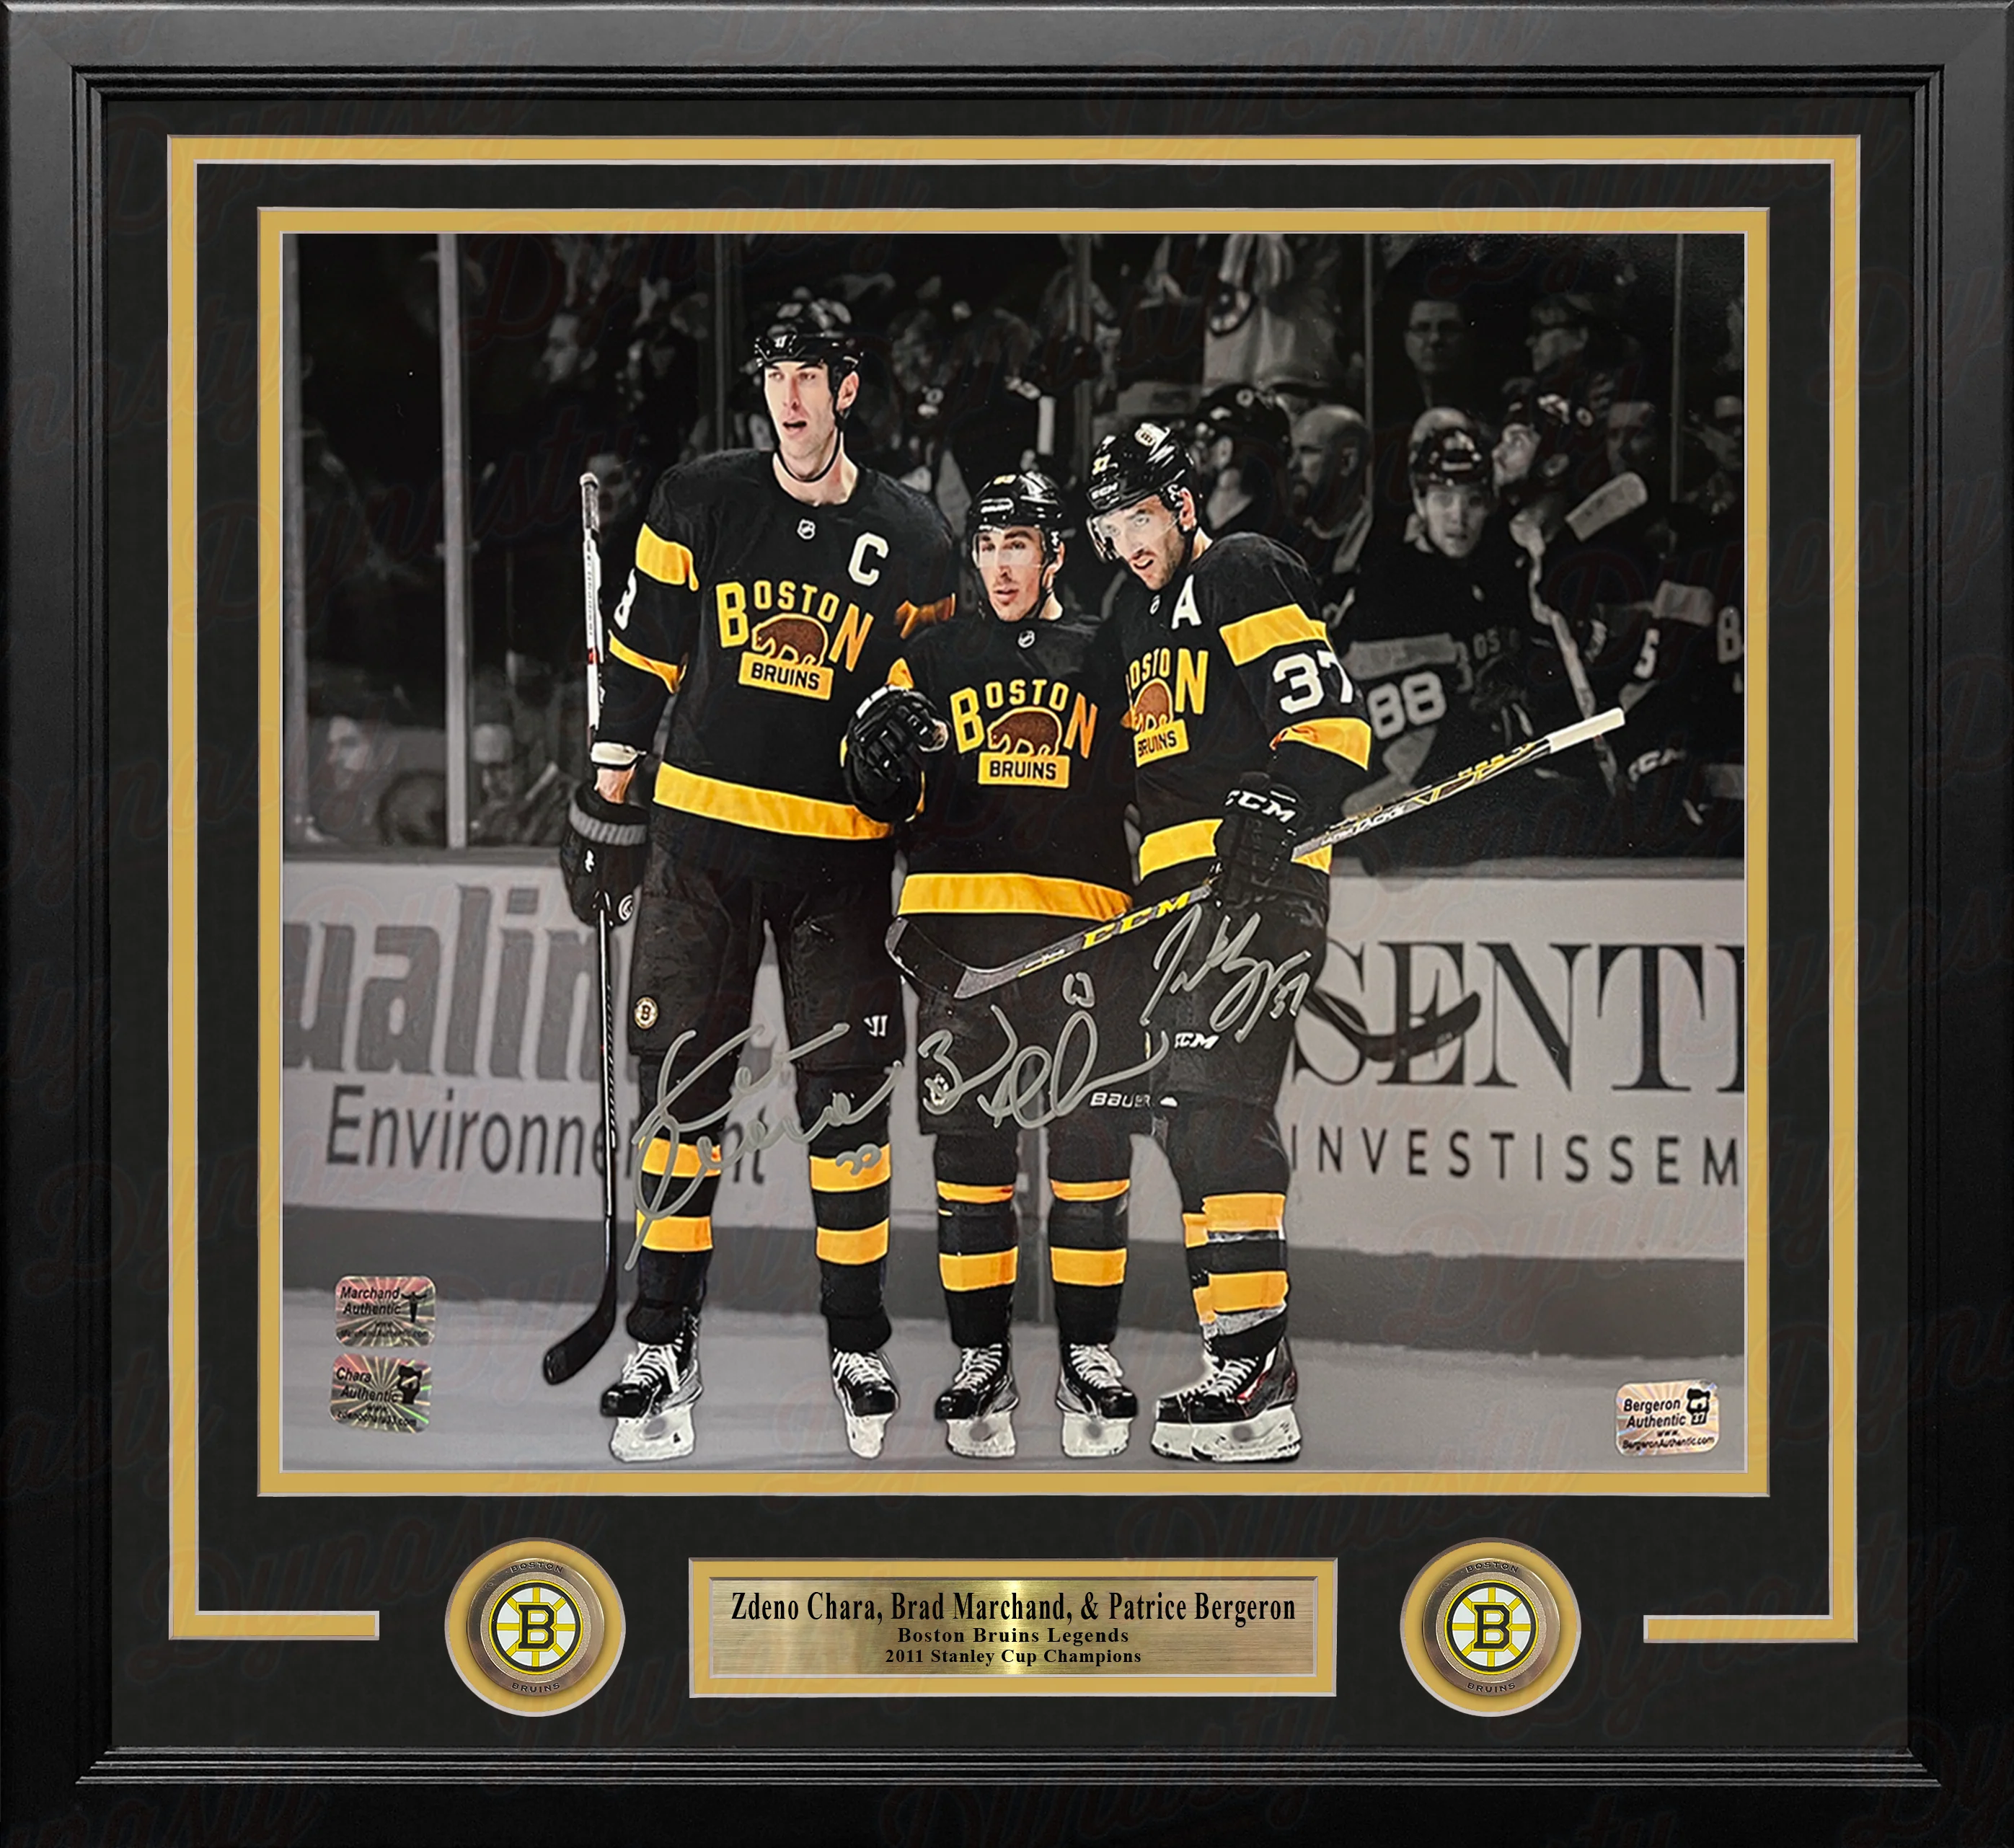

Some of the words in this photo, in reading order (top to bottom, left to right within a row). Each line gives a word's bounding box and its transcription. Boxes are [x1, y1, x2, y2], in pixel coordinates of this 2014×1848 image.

[847, 531, 889, 587] C
[1171, 574, 1202, 629] A
[716, 580, 874, 673] BOSTON
[750, 662, 821, 691] BRUINS
[1273, 650, 1353, 715] 37
[1369, 671, 1447, 740] 88
[950, 678, 1098, 759] BOSTON
[989, 759, 1057, 781] BRUINS
[1082, 891, 1191, 950] CCM
[340, 1287, 400, 1299] Marchand
[343, 1302, 402, 1316] Authentic
[336, 1367, 371, 1383] Chara
[340, 1384, 400, 1404] Authentic
[1623, 1398, 1681, 1414] Bergeron
[1627, 1413, 1686, 1428] Authentic
[511, 1562, 563, 1573] BOSTON
[1466, 1562, 1519, 1573] BOSTON
[732, 1592, 798, 1619] Zdeno
[808, 1592, 883, 1625] Chara,
[891, 1592, 944, 1619] Brad
[953, 1592, 1072, 1625] Marchand,
[1081, 1592, 1098, 1619] &
[1109, 1592, 1186, 1619] Patrice
[1195, 1593, 1296, 1627] Bergeron
[516, 1602, 557, 1651] B
[898, 1627, 965, 1642] Boston
[973, 1627, 1039, 1643] Bruins
[1048, 1627, 1129, 1646] Legends
[1472, 1602, 1512, 1651] B
[885, 1649, 924, 1663] 2011
[932, 1649, 995, 1666] Stanley
[1002, 1649, 1037, 1666] Cup
[1044, 1649, 1141, 1667] Champions
[512, 1682, 560, 1693] BRUINS
[1467, 1682, 1516, 1693] BRUINS
